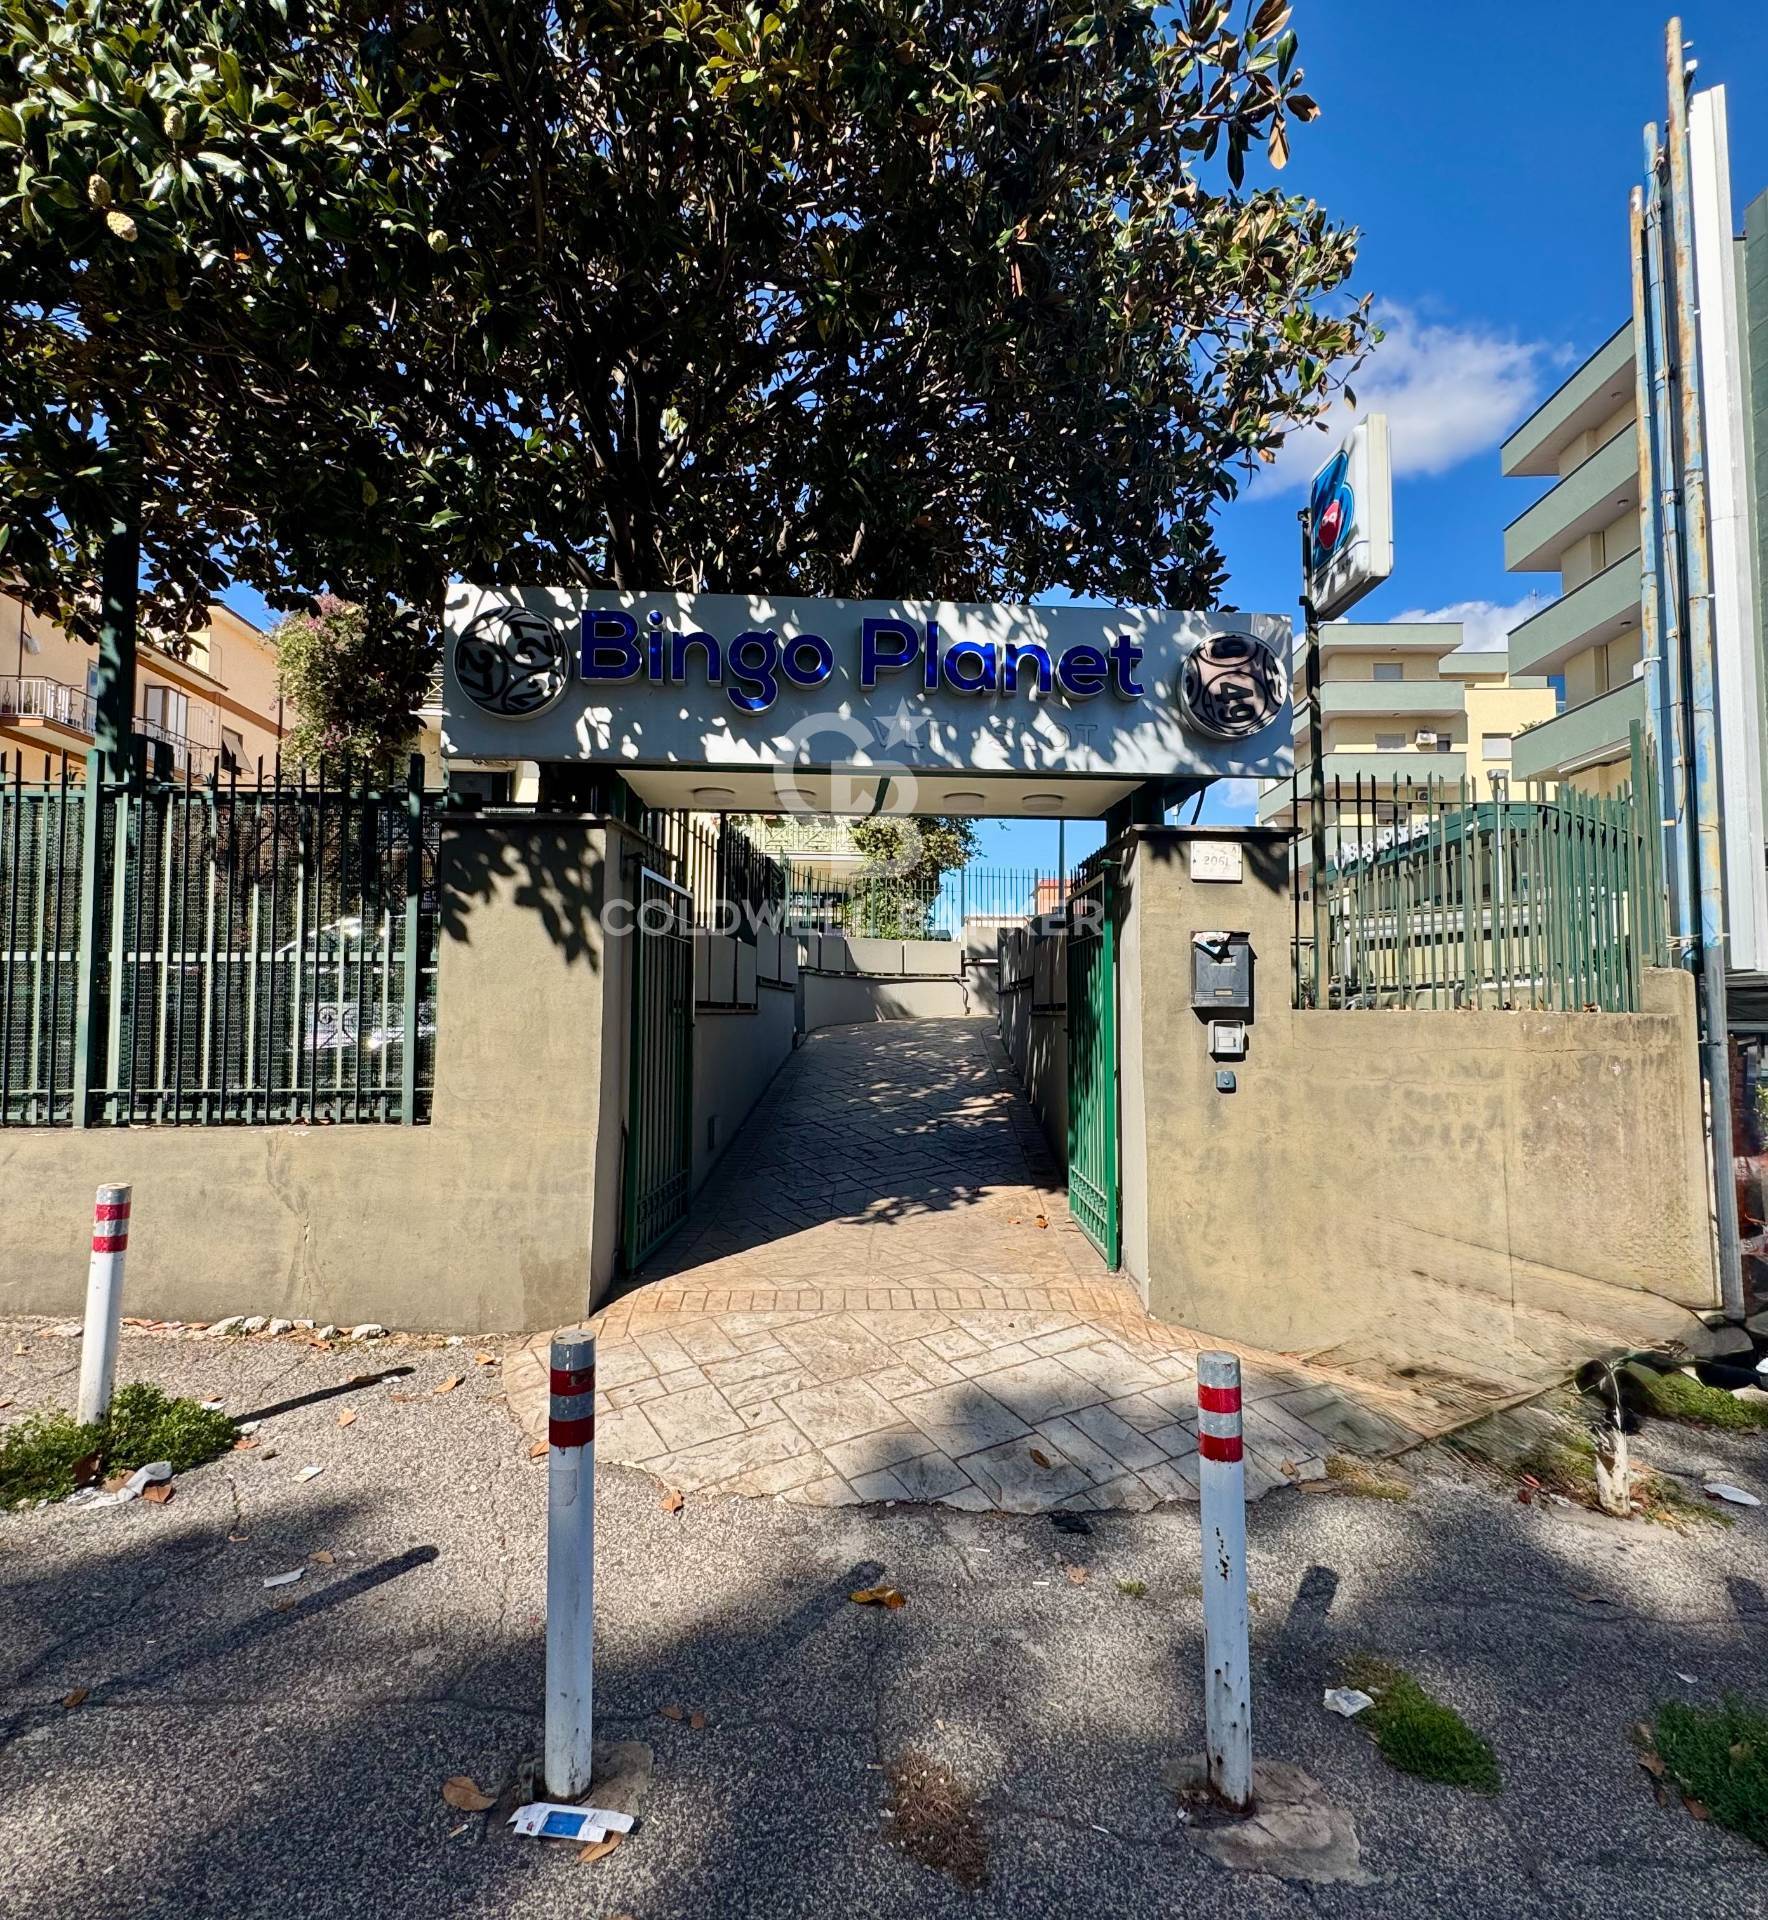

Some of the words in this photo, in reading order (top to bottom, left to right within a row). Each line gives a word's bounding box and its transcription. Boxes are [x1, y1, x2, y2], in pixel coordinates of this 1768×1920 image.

[580, 609, 835, 717] Bingo
[860, 617, 1146, 701] Planet
[1214, 681, 1255, 724] 49
